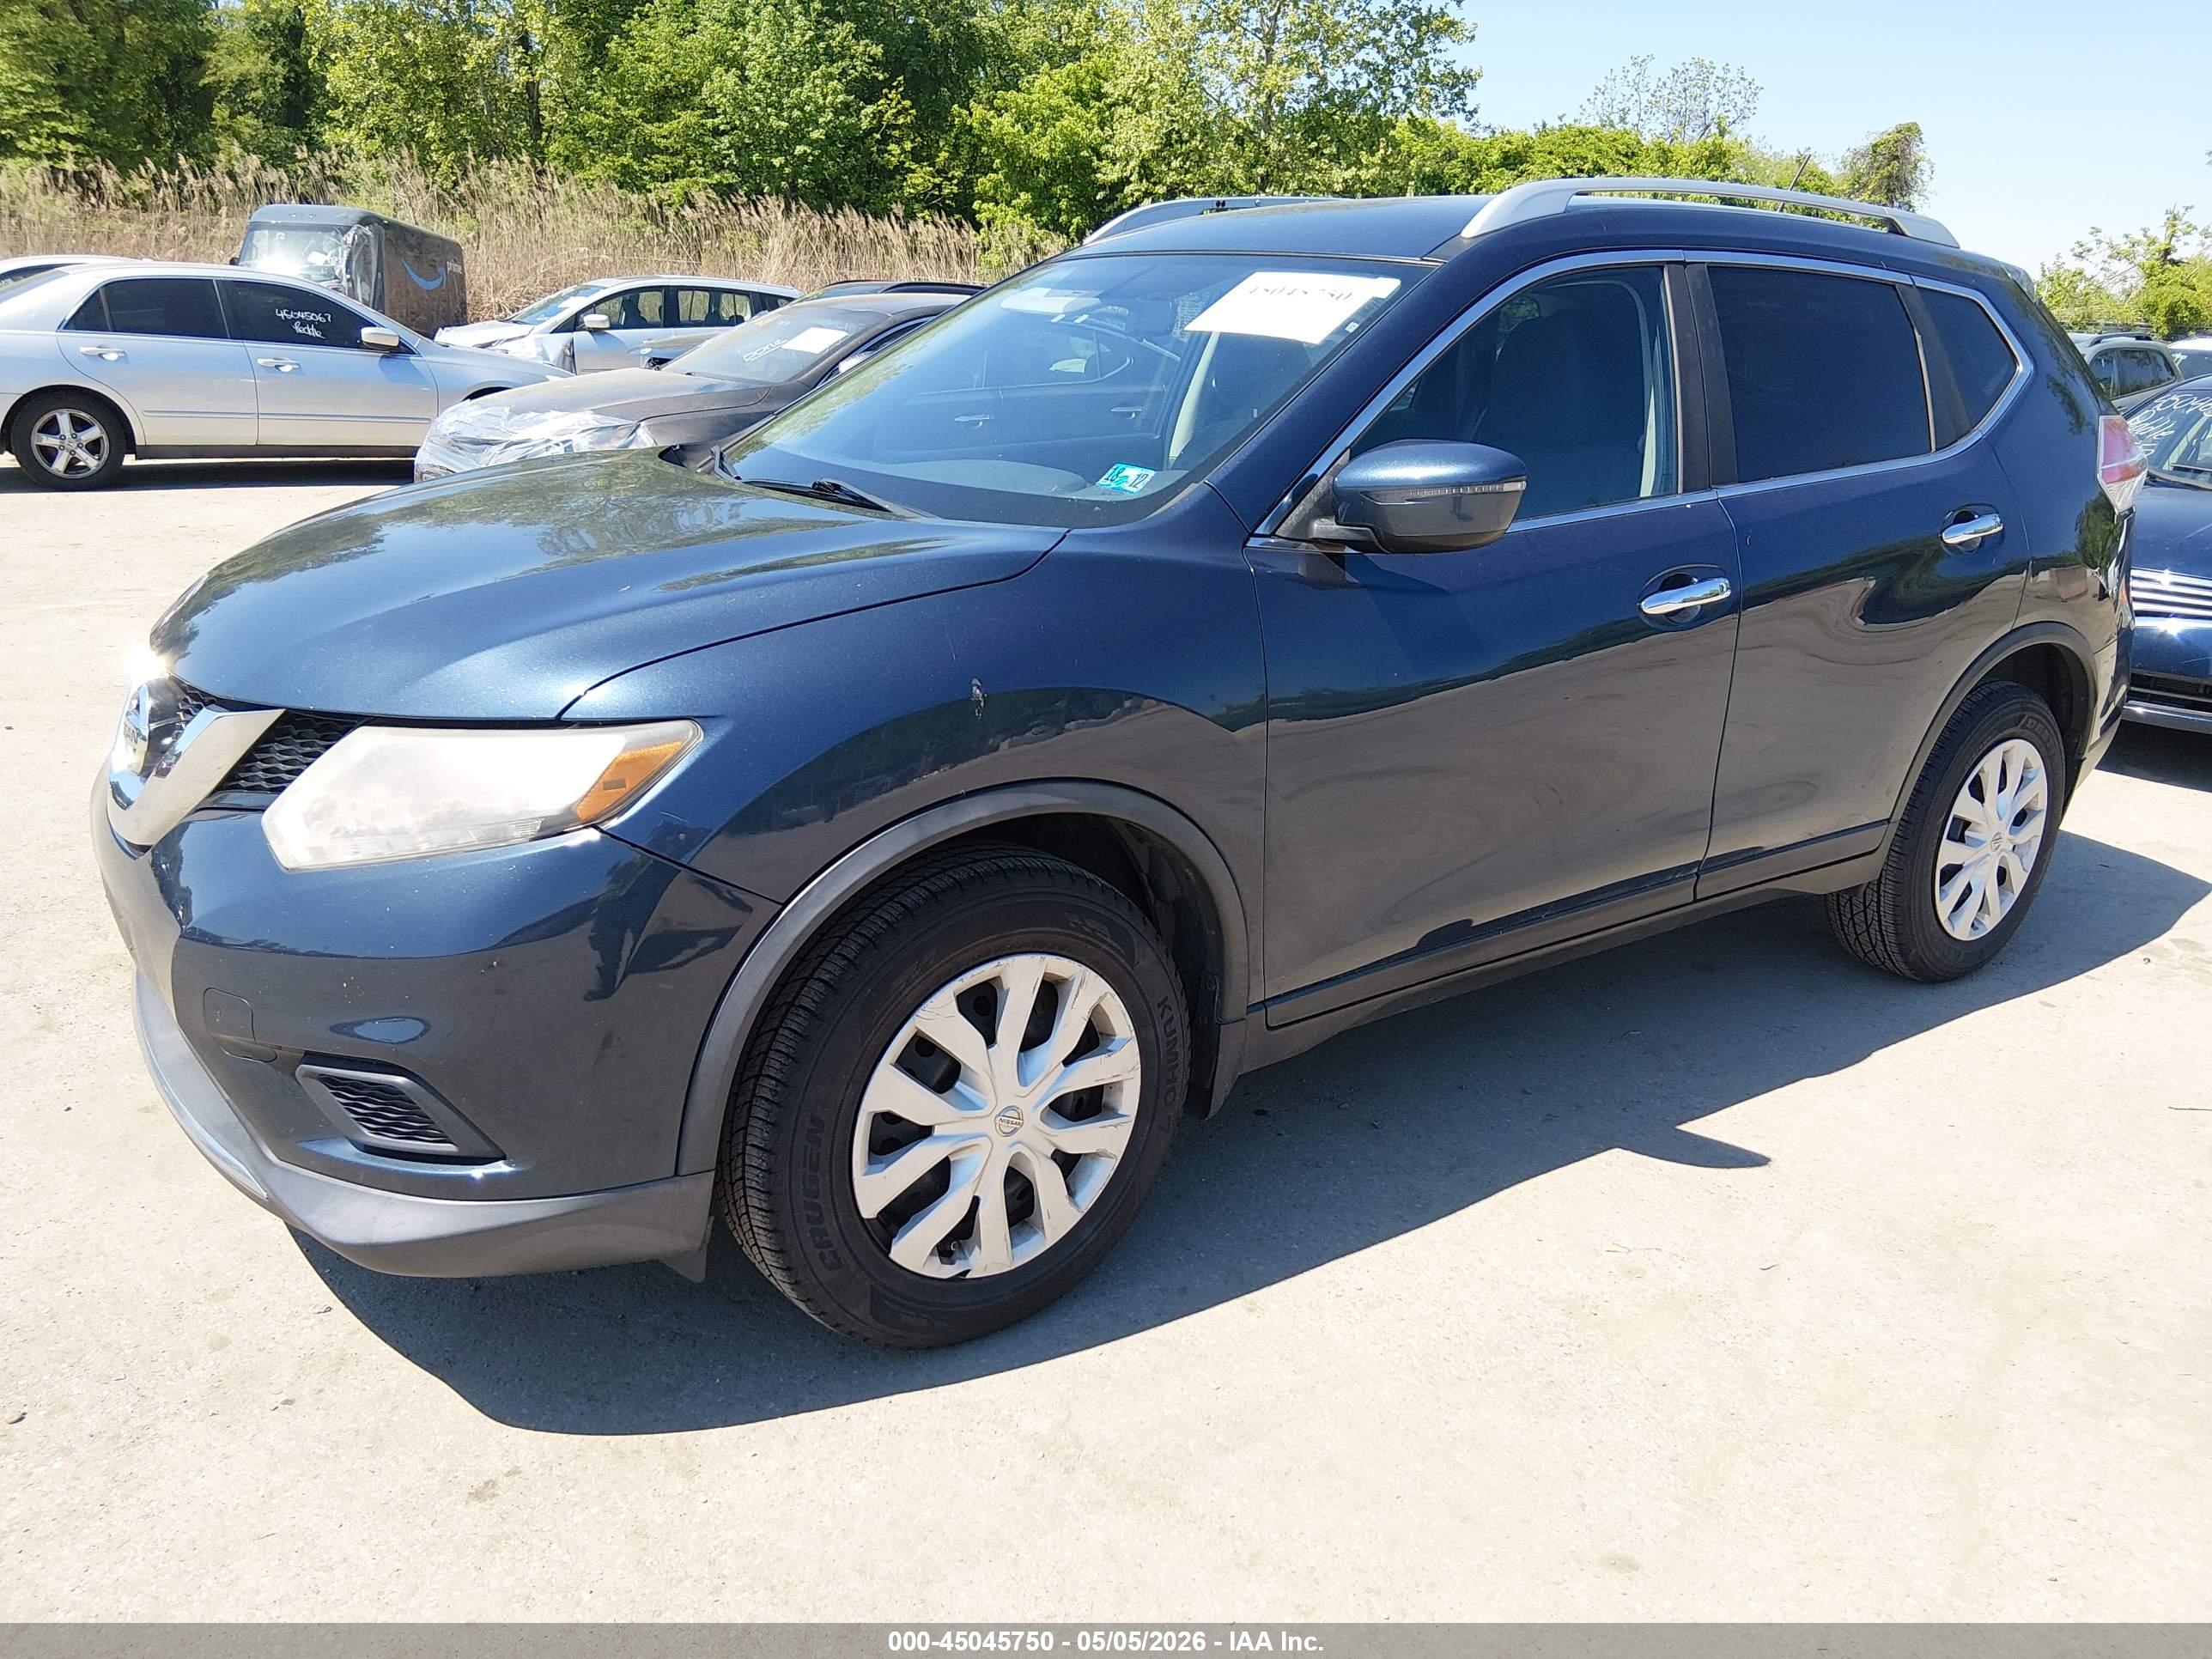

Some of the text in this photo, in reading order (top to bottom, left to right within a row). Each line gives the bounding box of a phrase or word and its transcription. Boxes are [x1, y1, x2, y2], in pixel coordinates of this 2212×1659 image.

[1158, 994, 1179, 1108] KUMHO
[999, 1117, 1022, 1127] NISSAN
[802, 1115, 844, 1272] CRUGEN
